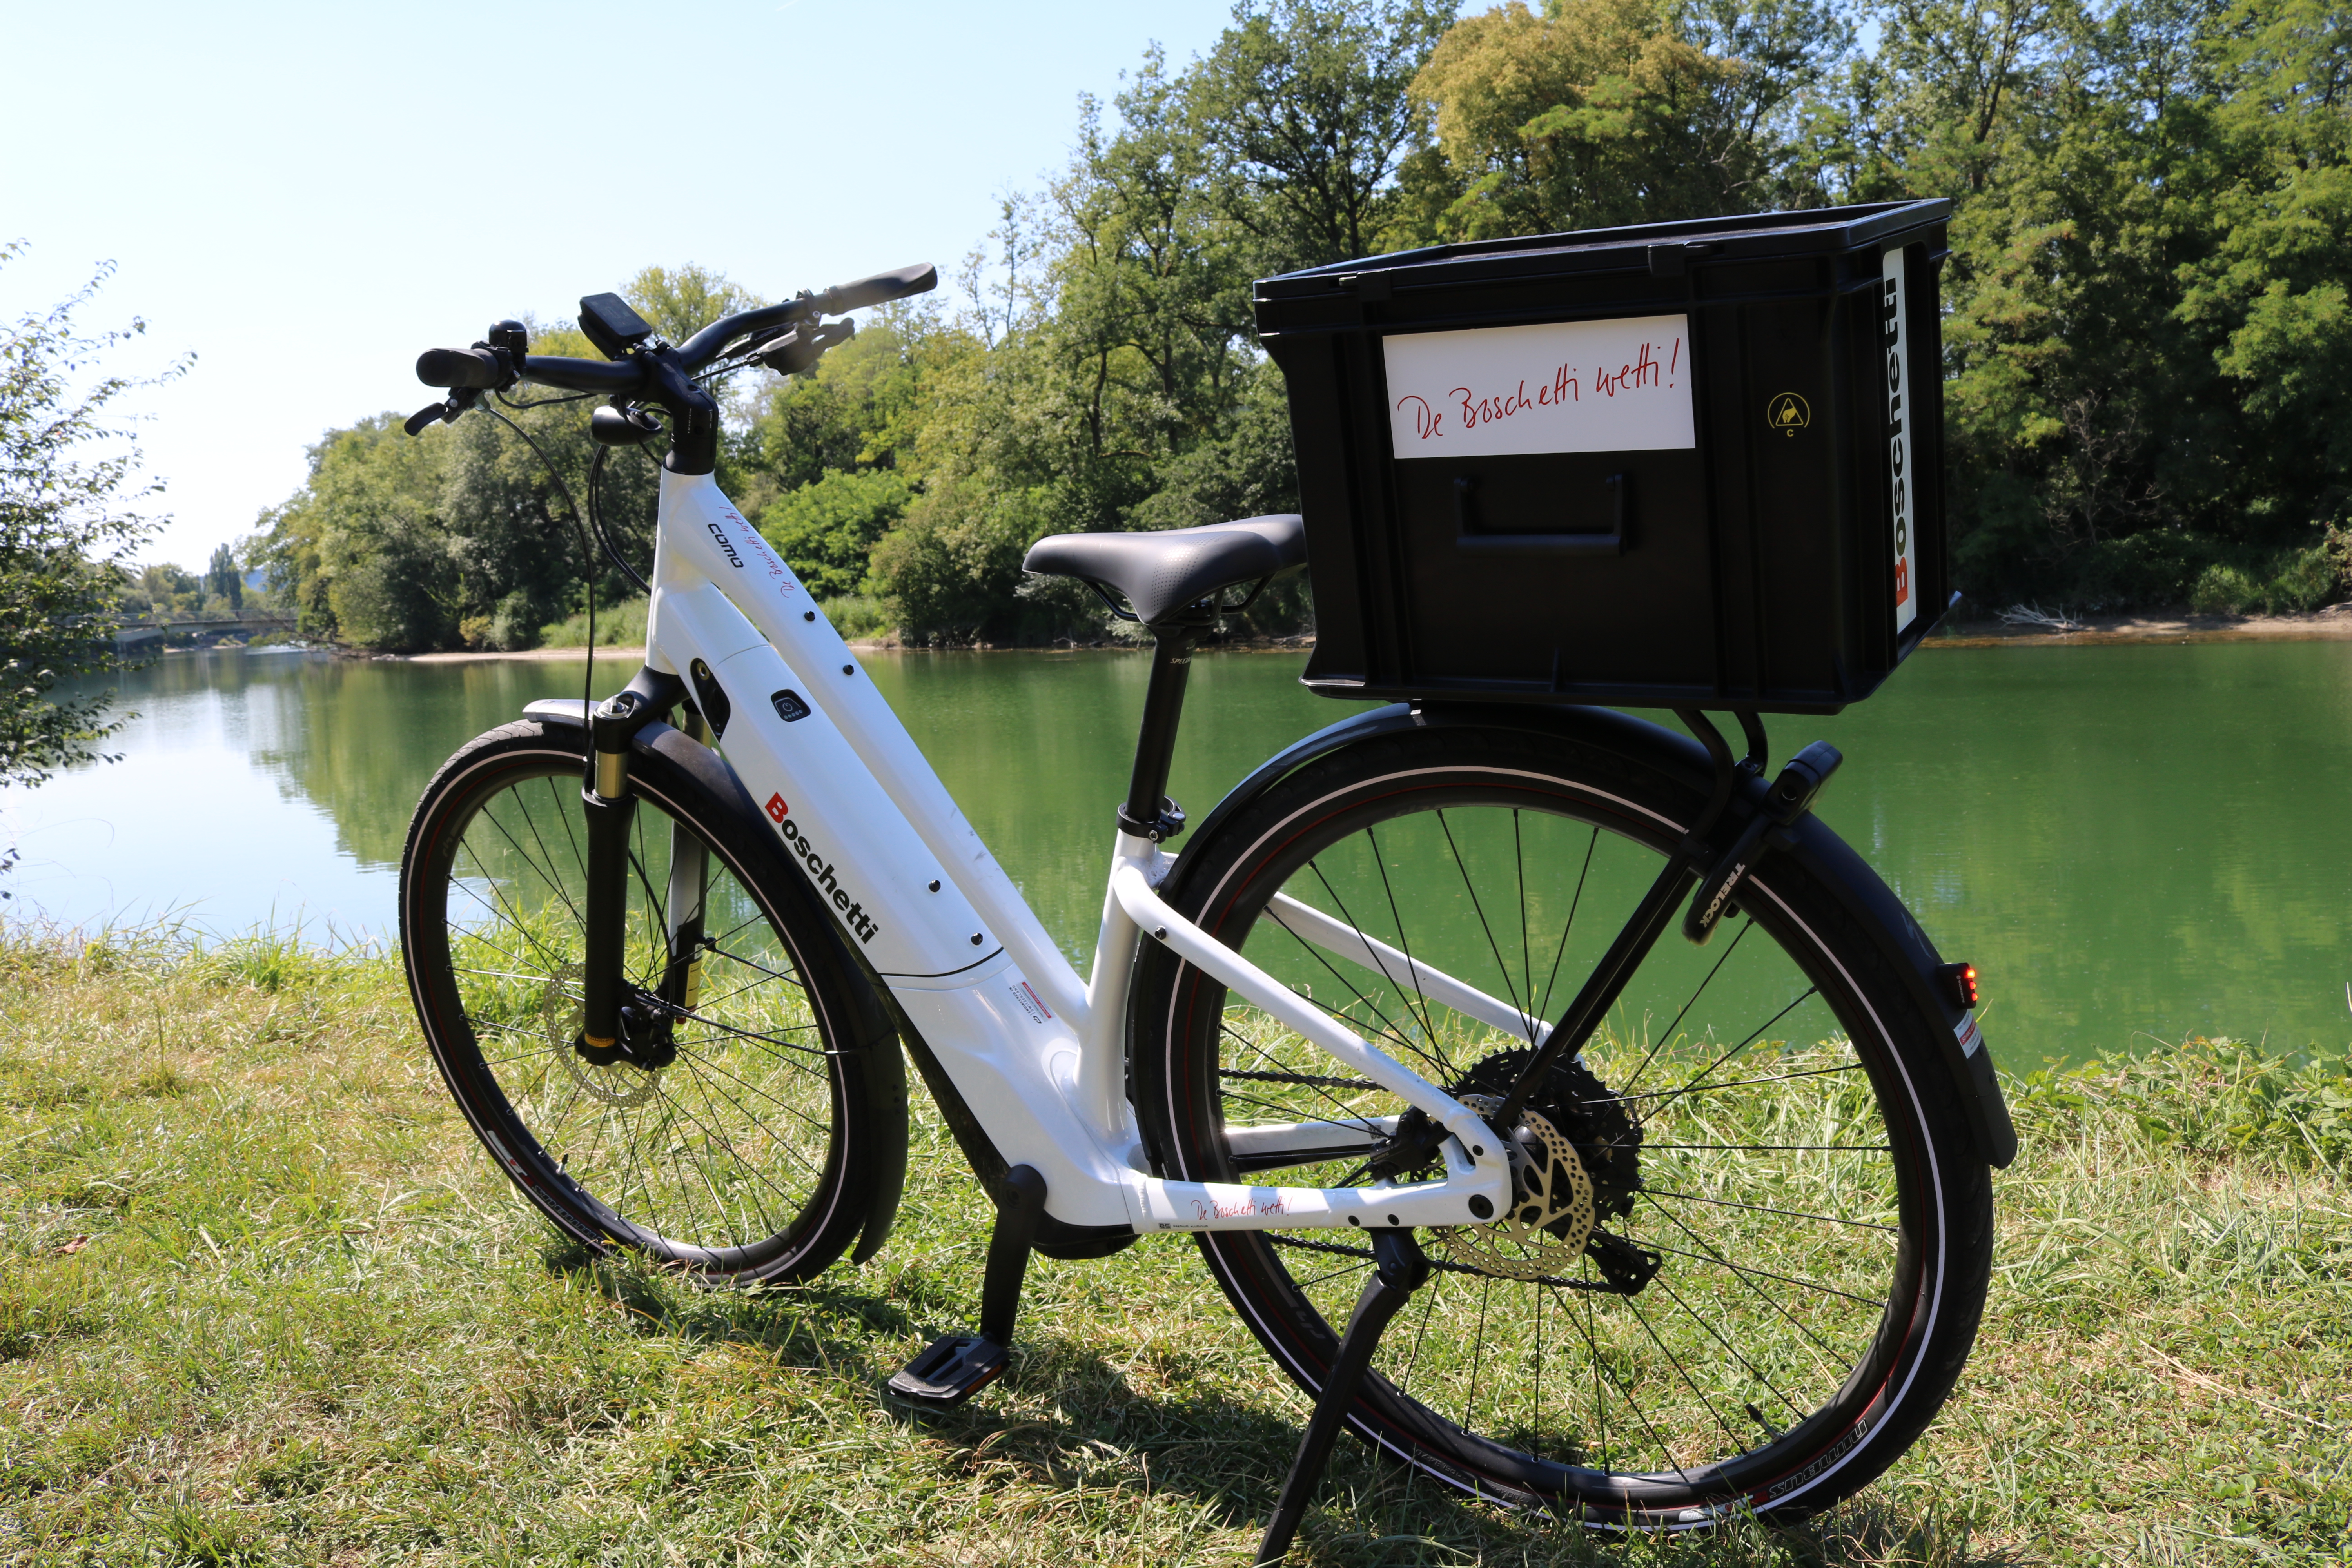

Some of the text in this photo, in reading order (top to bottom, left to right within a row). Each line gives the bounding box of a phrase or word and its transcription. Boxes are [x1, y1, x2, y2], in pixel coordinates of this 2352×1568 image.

[1397, 396, 1443, 439] De
[1448, 363, 1579, 428] Boschetti
[1883, 277, 1908, 608] Boschetti
[744, 536, 783, 580] Boschetti
[780, 581, 795, 598] De
[765, 791, 879, 944] Boschetti
[1699, 863, 1746, 928] TRELOCK
[1012, 985, 1034, 1012] SWITZERLAND
[1013, 991, 1031, 1014] ENGINEERED
[1191, 1200, 1207, 1220] De
[1210, 1198, 1256, 1219] Boschetti
